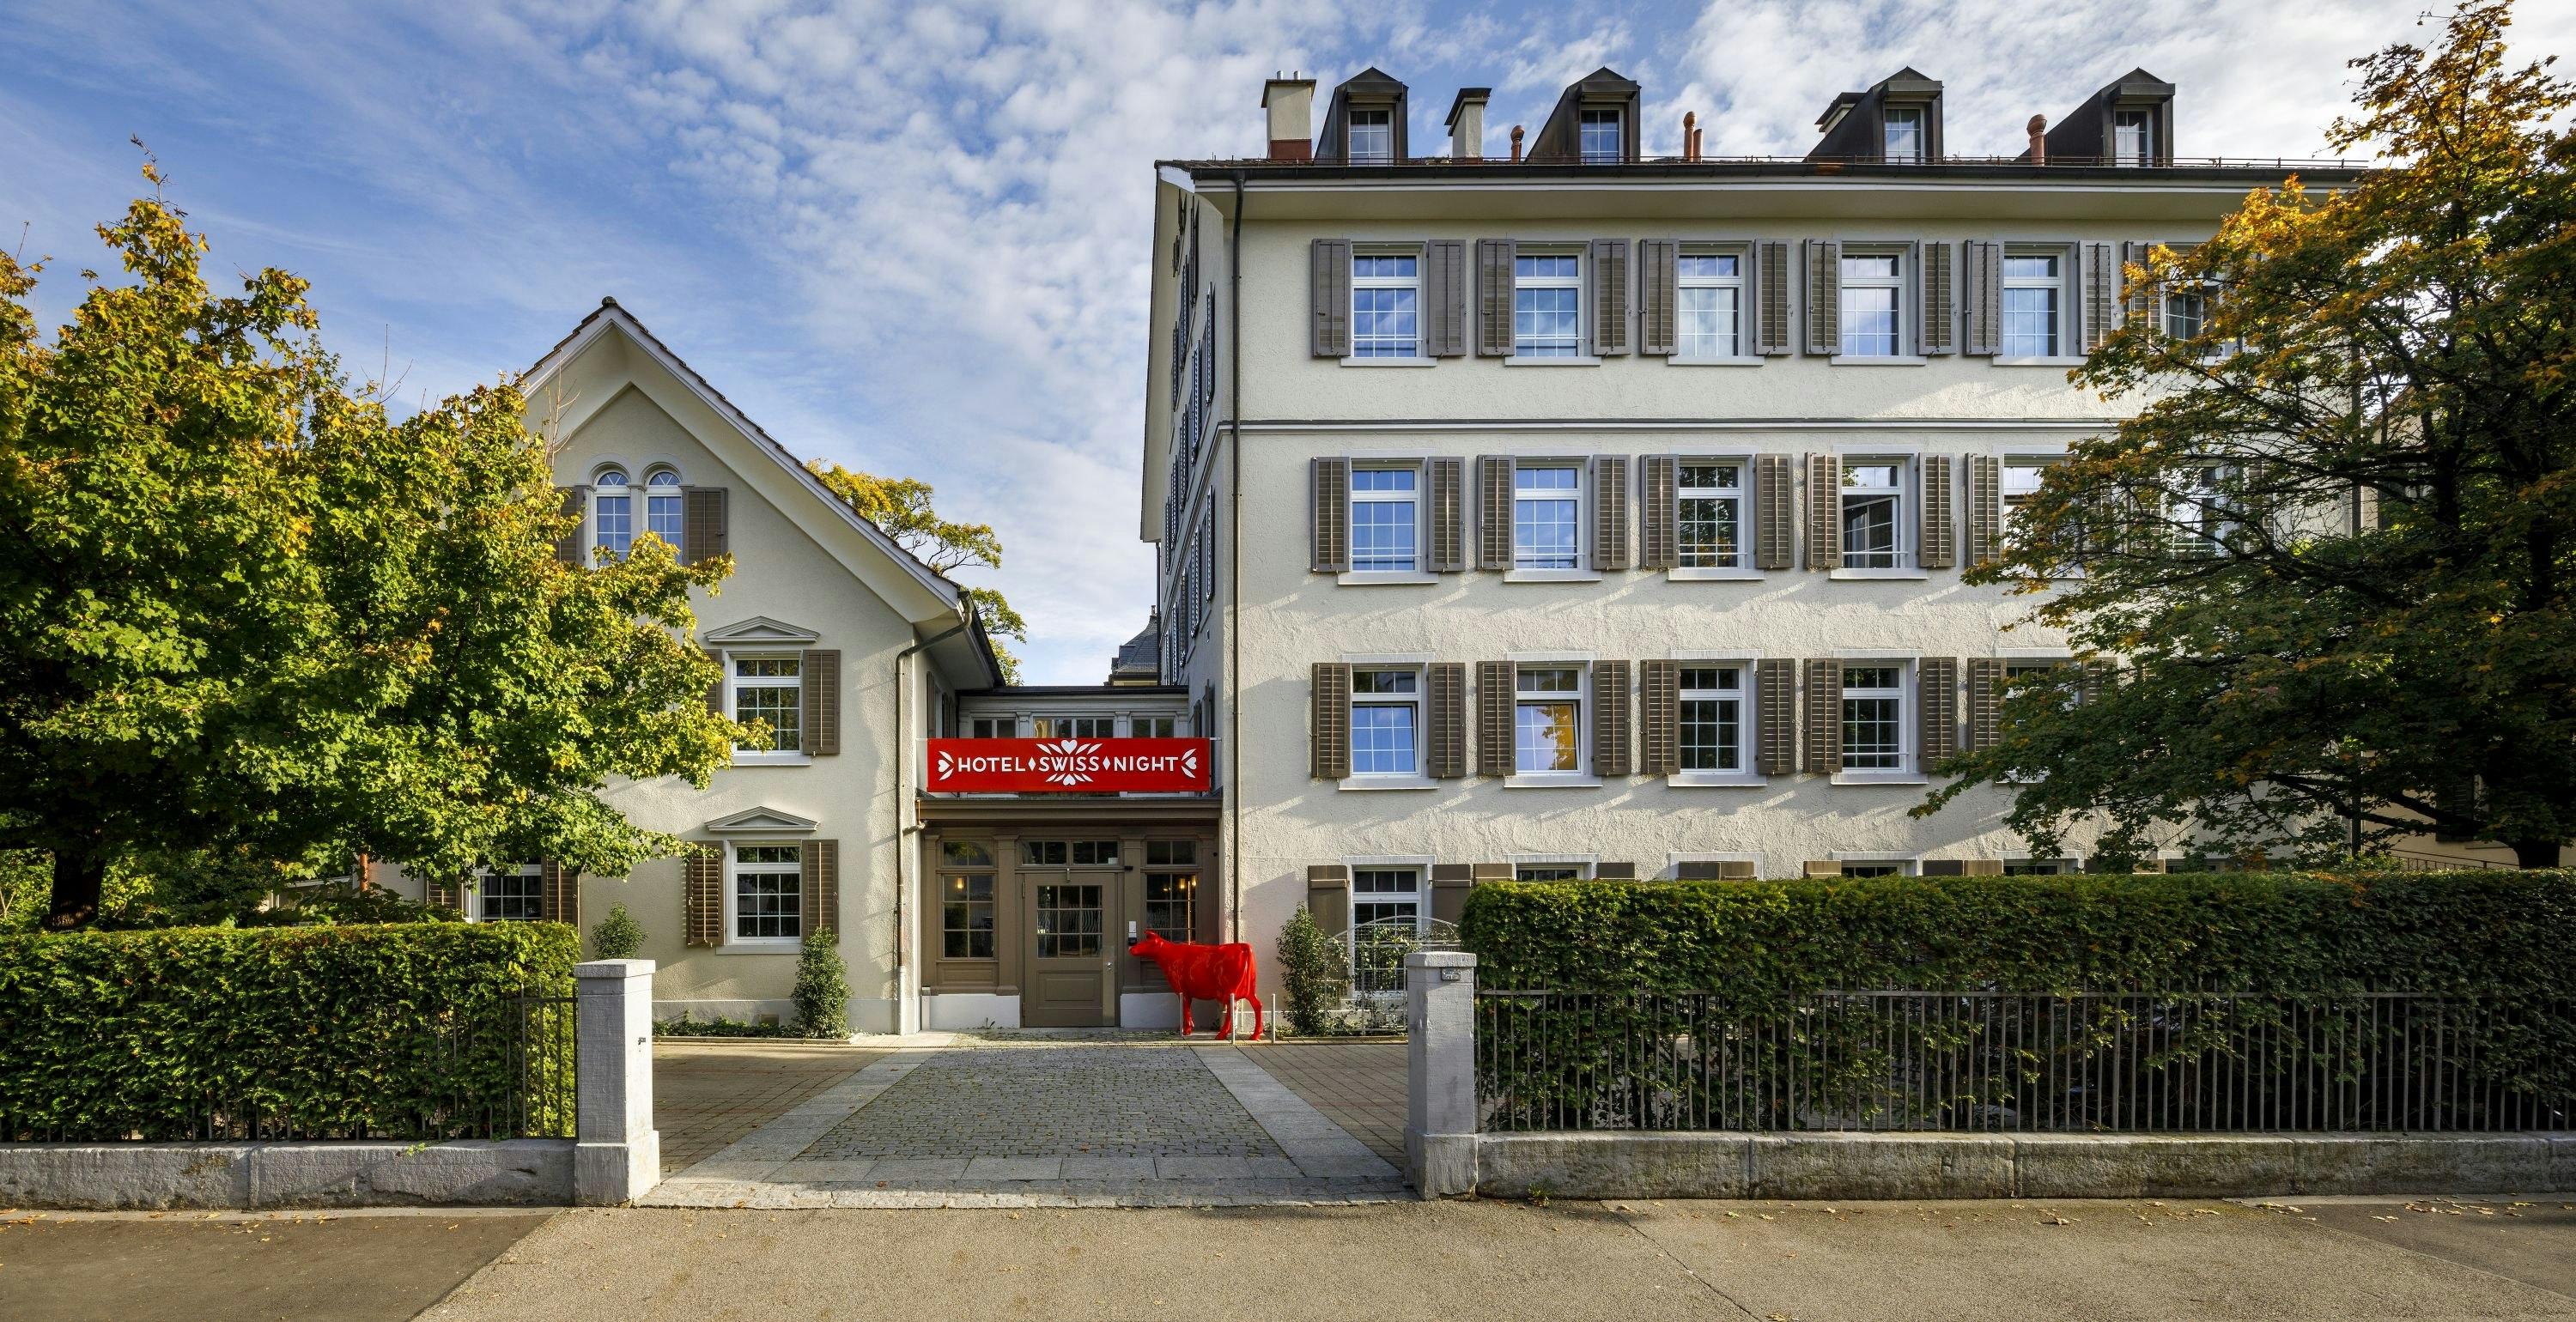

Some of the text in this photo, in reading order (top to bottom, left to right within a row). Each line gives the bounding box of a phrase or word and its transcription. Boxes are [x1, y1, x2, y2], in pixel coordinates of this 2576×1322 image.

[957, 755, 1179, 773] HOTEL SWISS NIGHT
